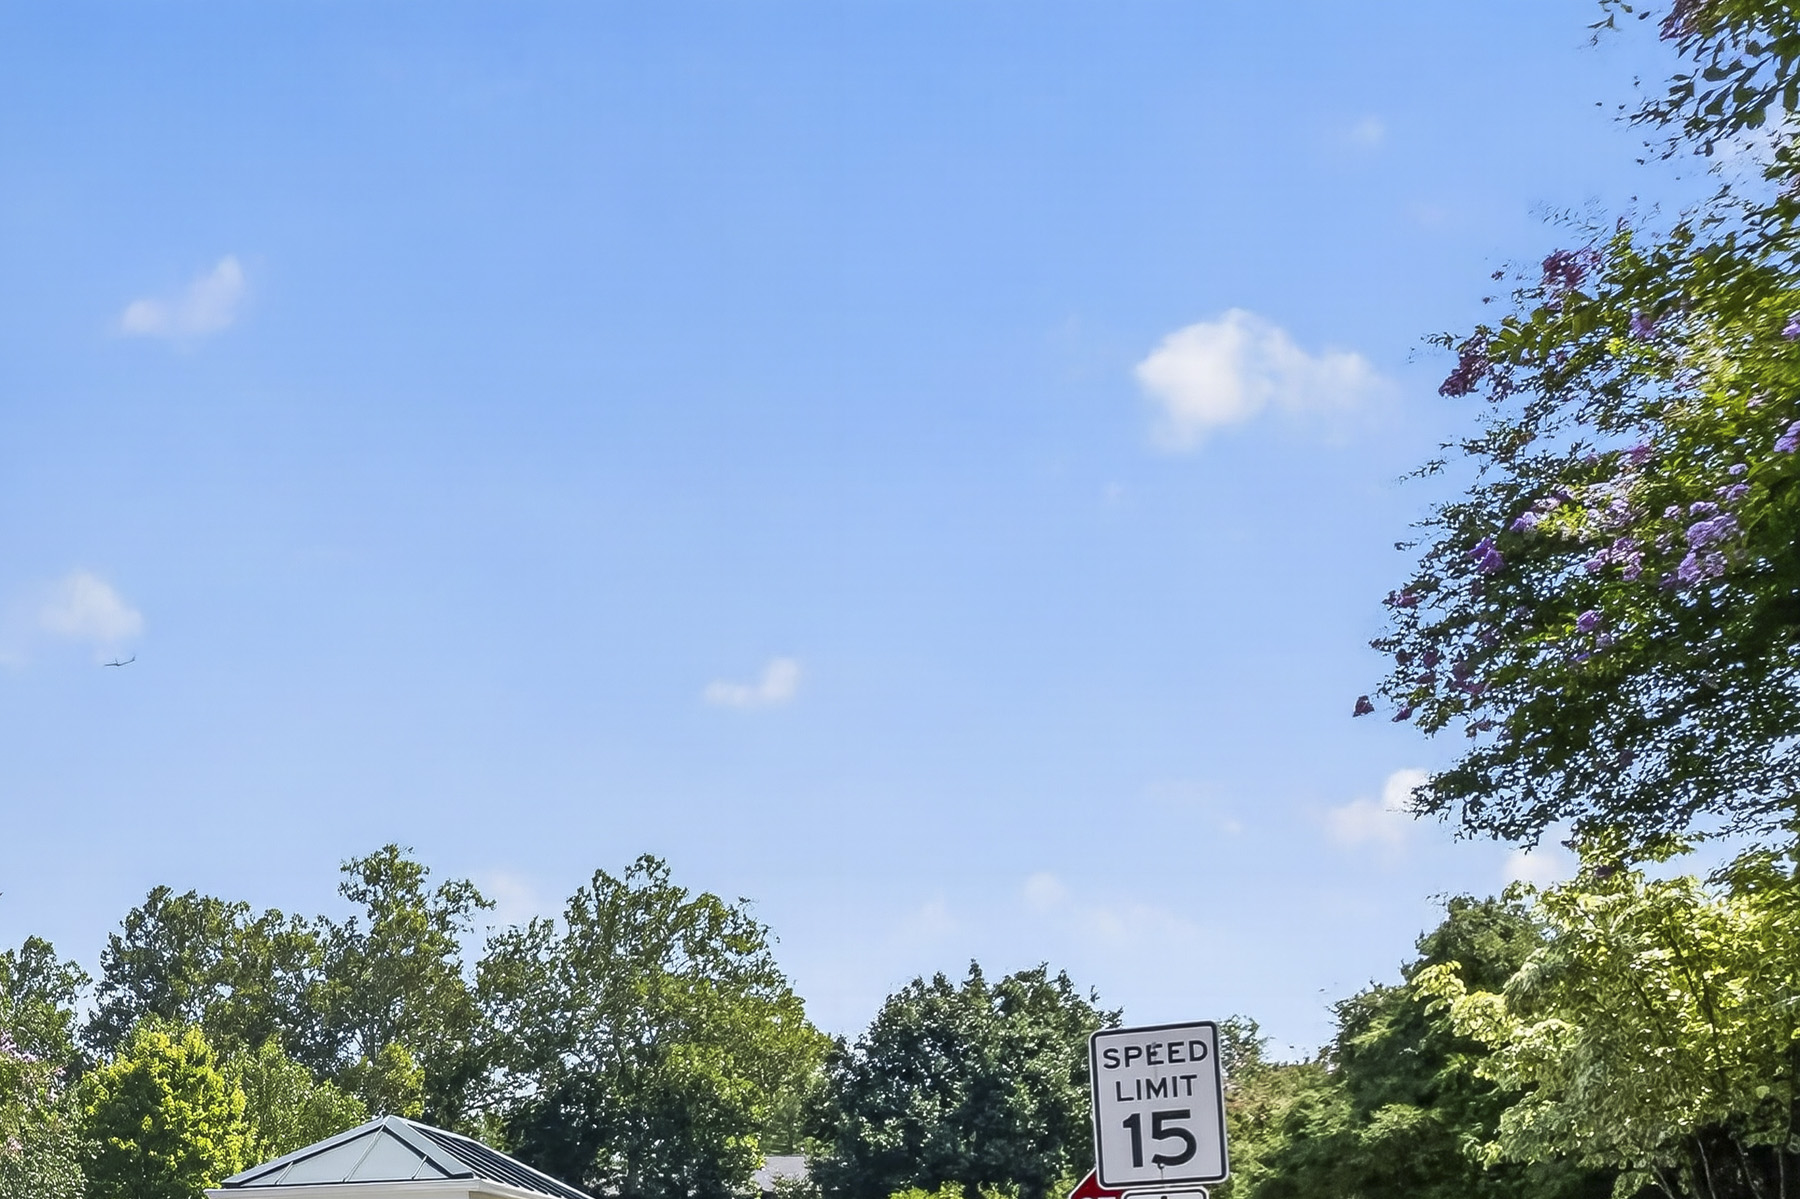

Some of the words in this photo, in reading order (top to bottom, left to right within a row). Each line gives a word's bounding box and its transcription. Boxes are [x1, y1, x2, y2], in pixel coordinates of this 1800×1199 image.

[1103, 1040, 1208, 1069] SPEED
[1116, 1075, 1197, 1102] LIMIT
[1123, 1109, 1197, 1168] 15
